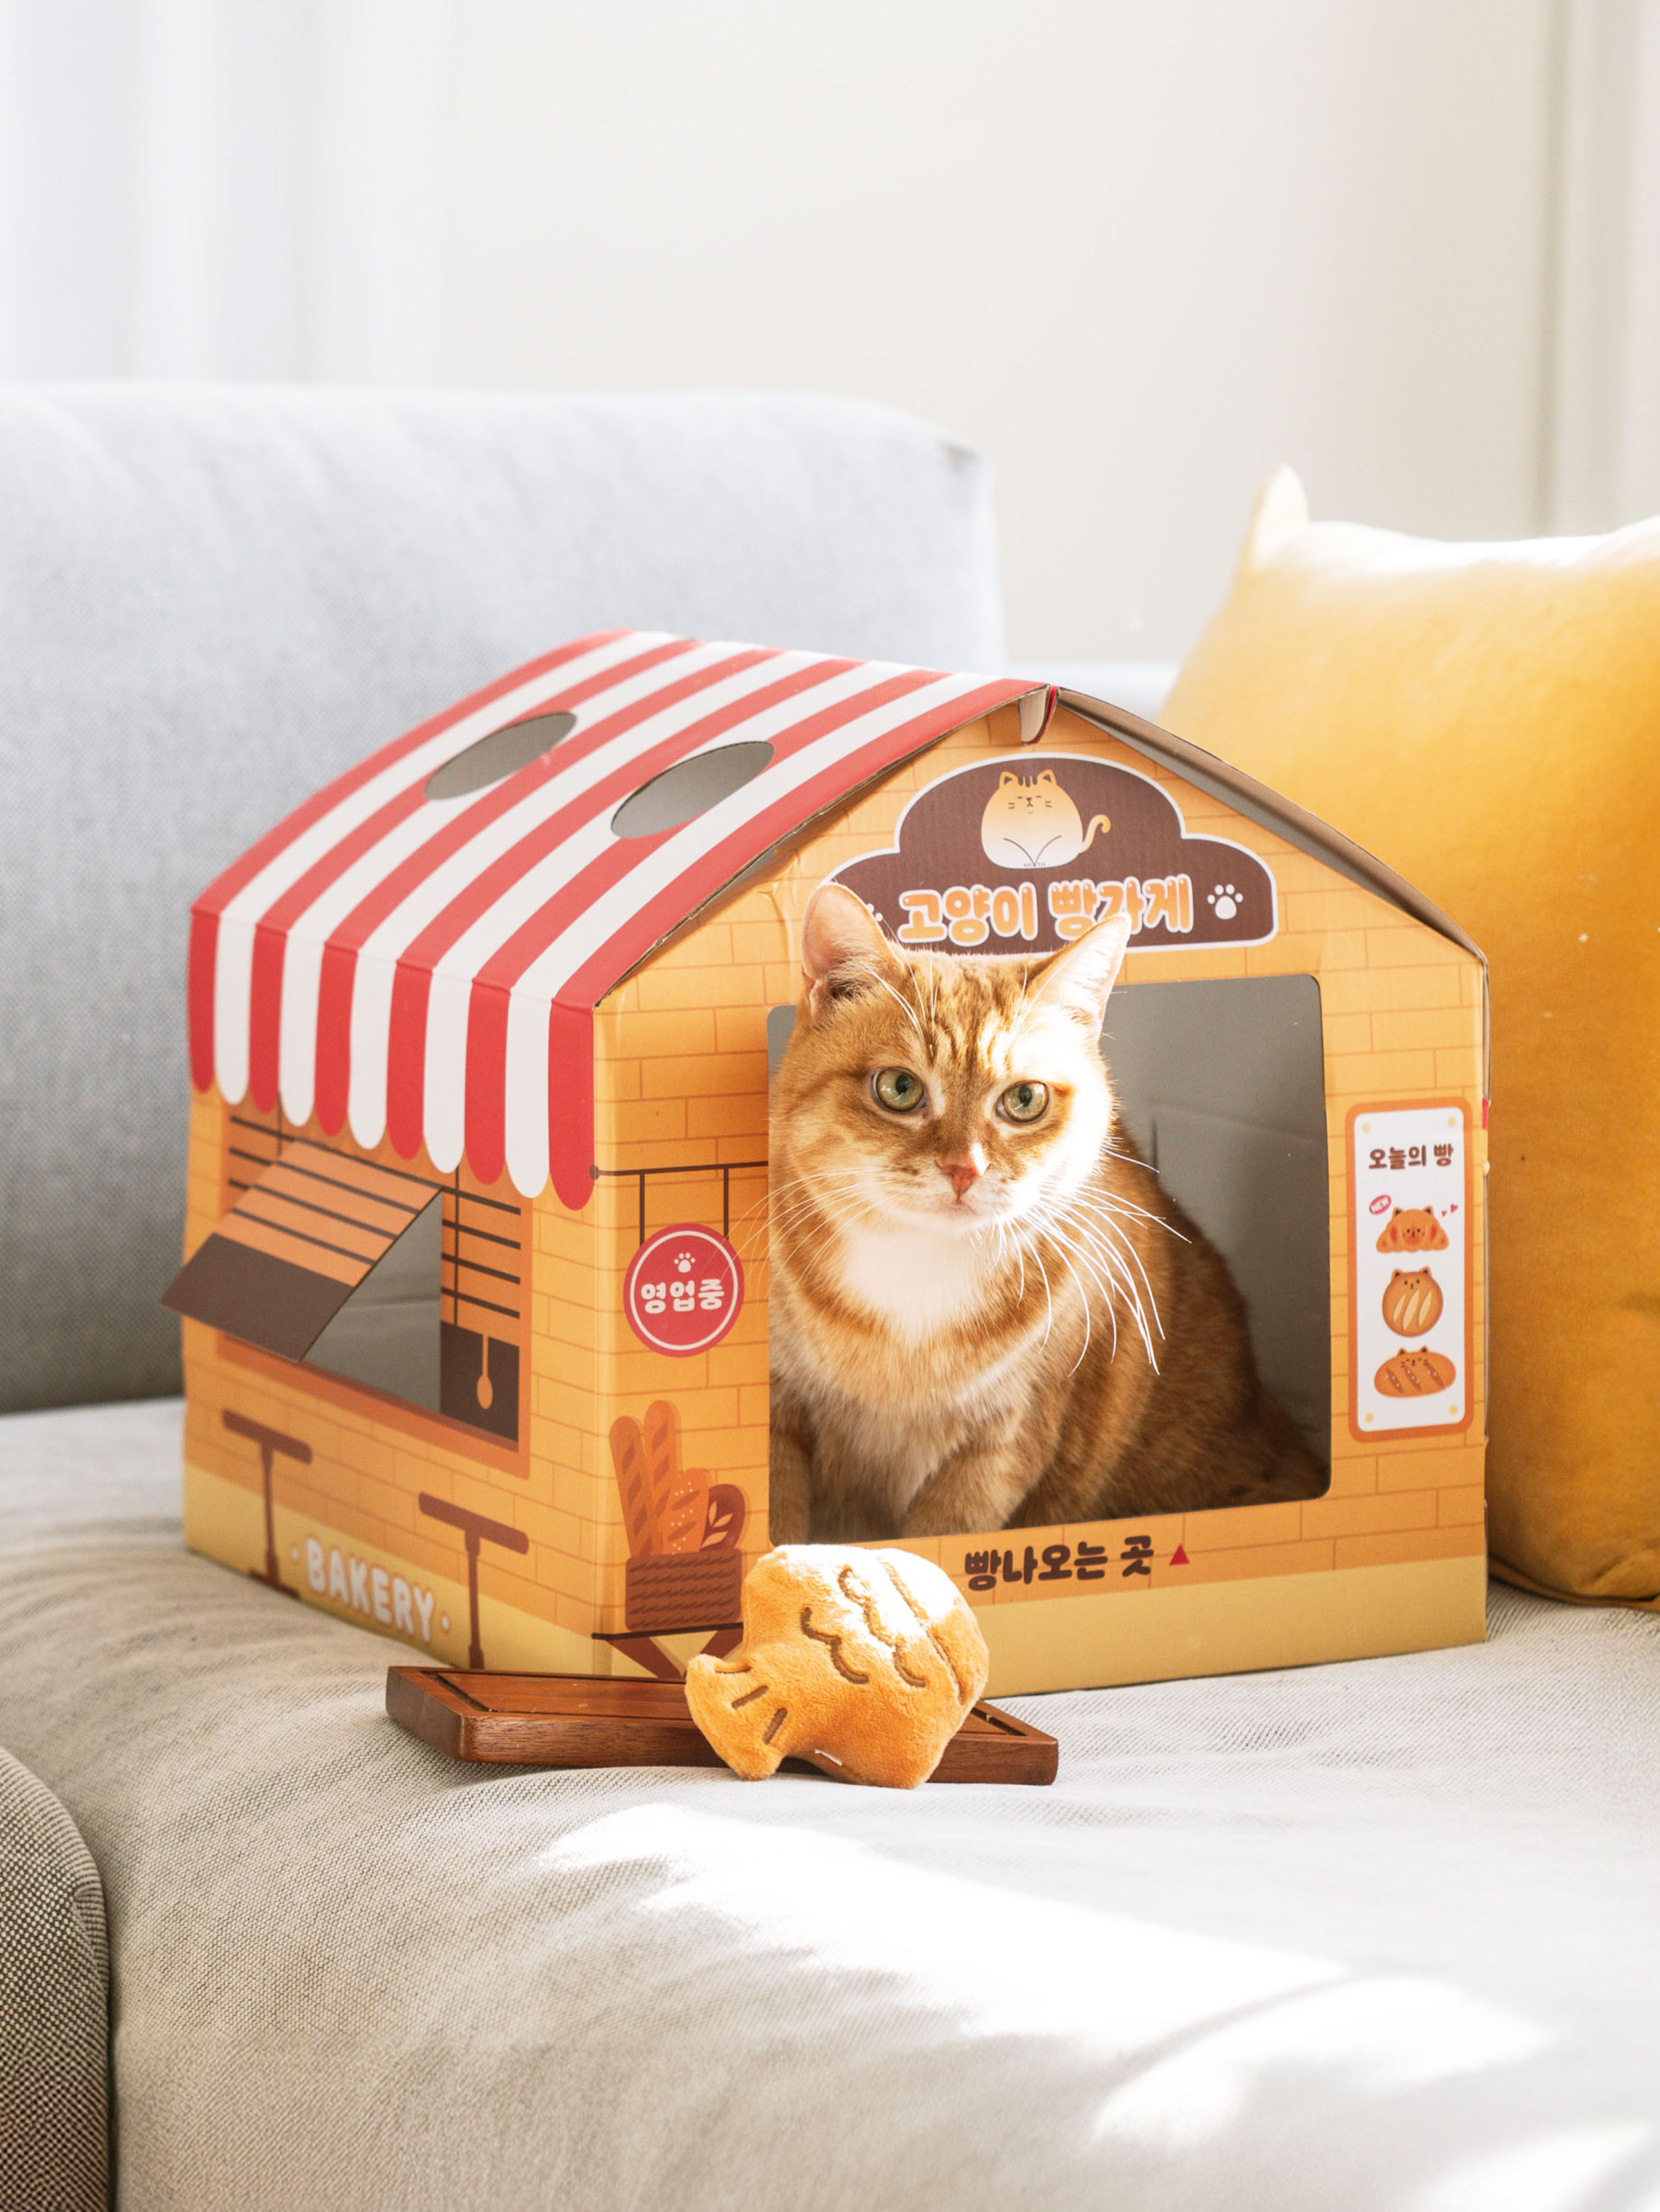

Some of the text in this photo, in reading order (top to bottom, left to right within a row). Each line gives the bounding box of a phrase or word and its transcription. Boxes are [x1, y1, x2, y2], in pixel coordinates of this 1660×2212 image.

[898, 874, 1194, 946] 고양이 빵가게
[1369, 1143, 1454, 1170] 오늘의 빵
[1370, 1196, 1390, 1214] NEW
[641, 1278, 724, 1314] 영업중
[965, 1535, 1154, 1591] 빵나오는 곳
[306, 1537, 434, 1642] BAKERY
